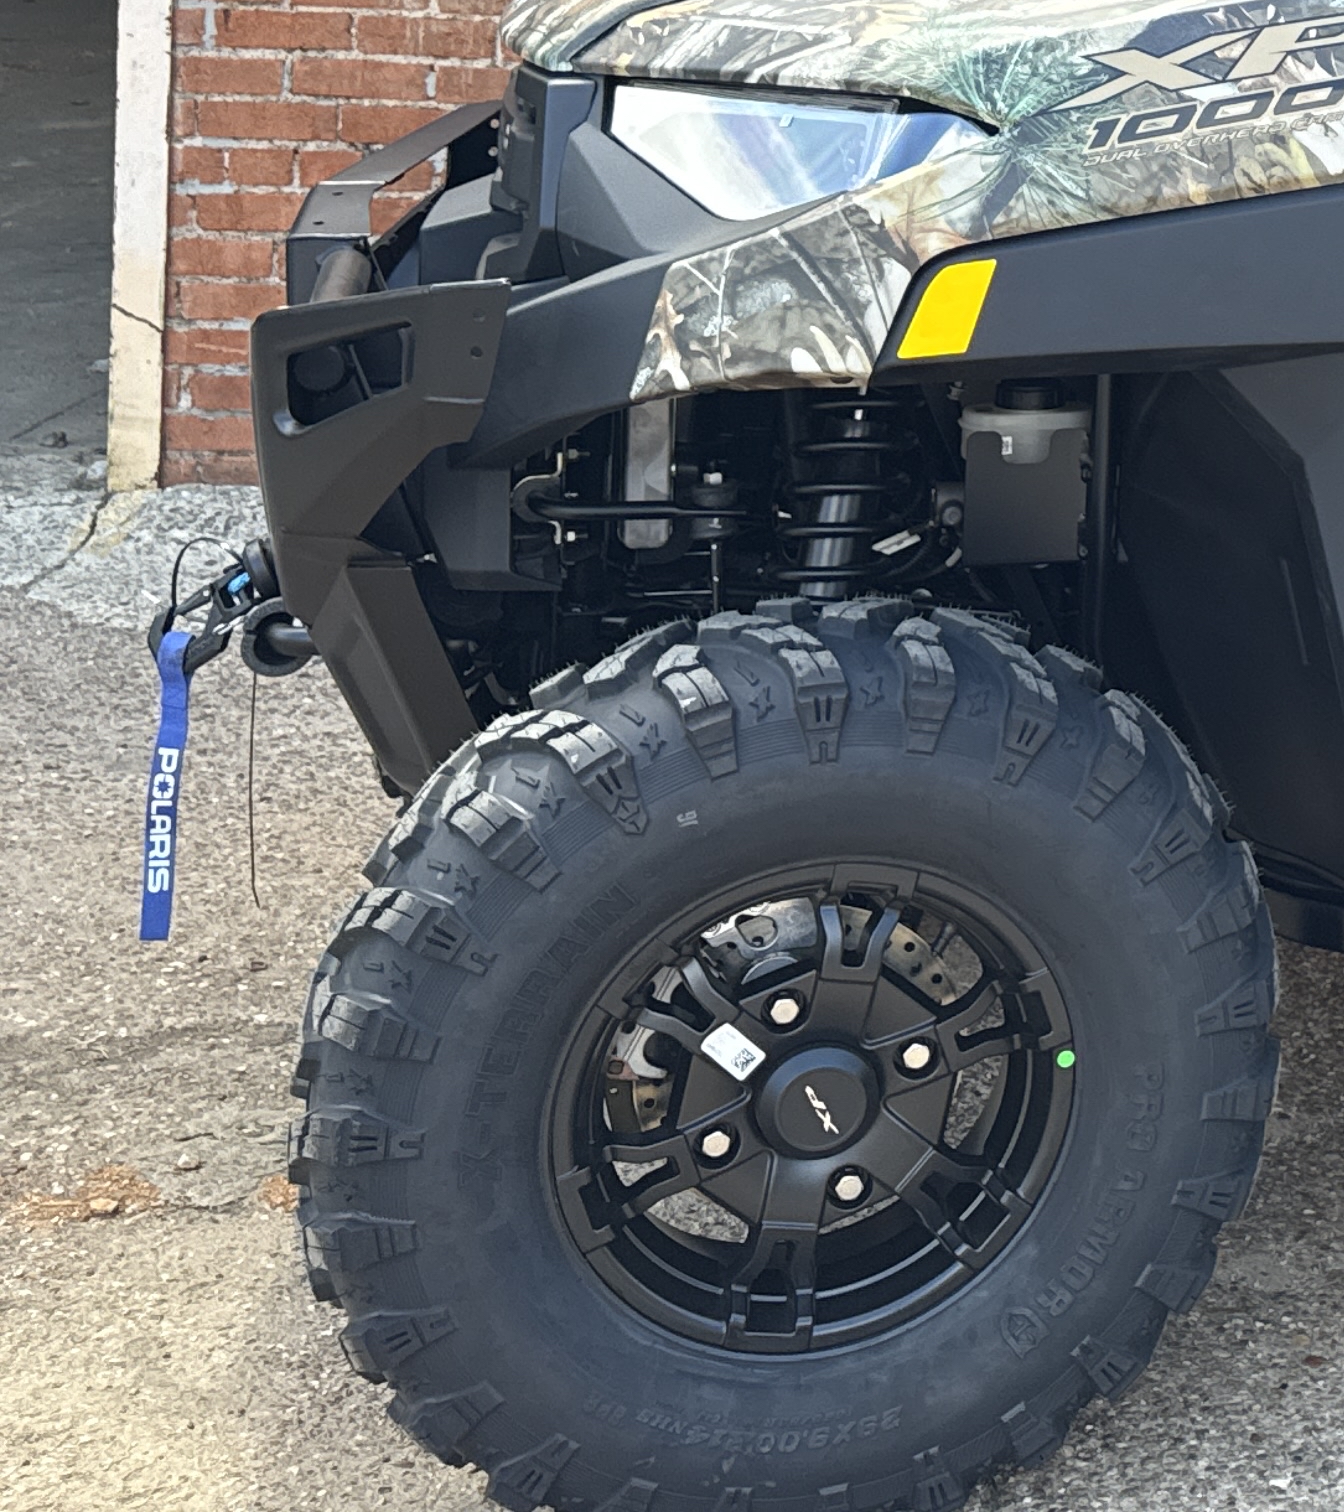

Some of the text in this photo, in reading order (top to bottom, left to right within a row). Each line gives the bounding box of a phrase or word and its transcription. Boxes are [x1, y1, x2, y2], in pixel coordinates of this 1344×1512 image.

[1083, 148, 1147, 167] DUAL
[1153, 121, 1286, 154] OVERHEAD
[147, 747, 179, 894] POLARIS
[456, 882, 642, 1190] X-TERRAIN
[805, 1085, 840, 1135] XP
